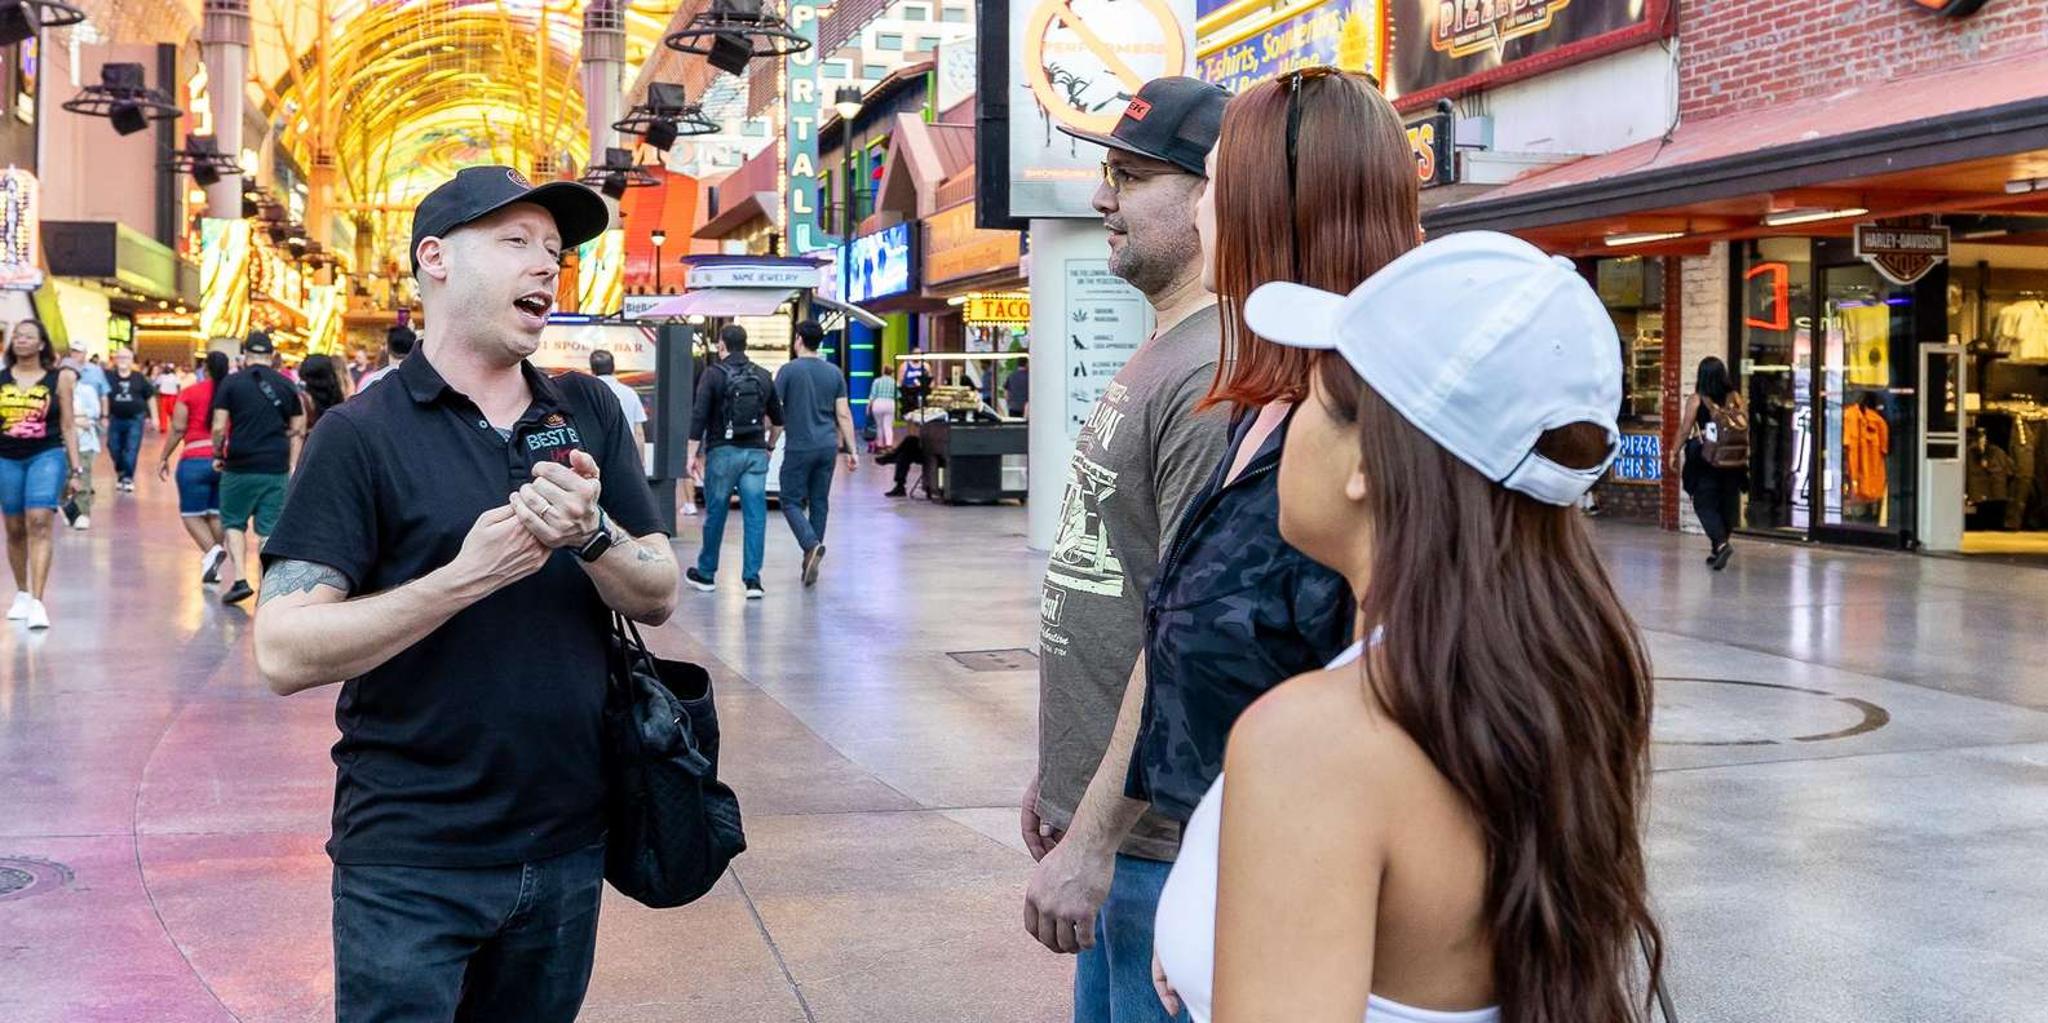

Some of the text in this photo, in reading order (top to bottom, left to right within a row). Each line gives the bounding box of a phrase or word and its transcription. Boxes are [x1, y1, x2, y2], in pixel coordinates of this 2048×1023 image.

[1865, 232, 1943, 249] HARLEY-DAVIDSON
[732, 272, 799, 281] NAME JEWELRY
[526, 428, 567, 450] BEST
[1614, 457, 1643, 478] THE
